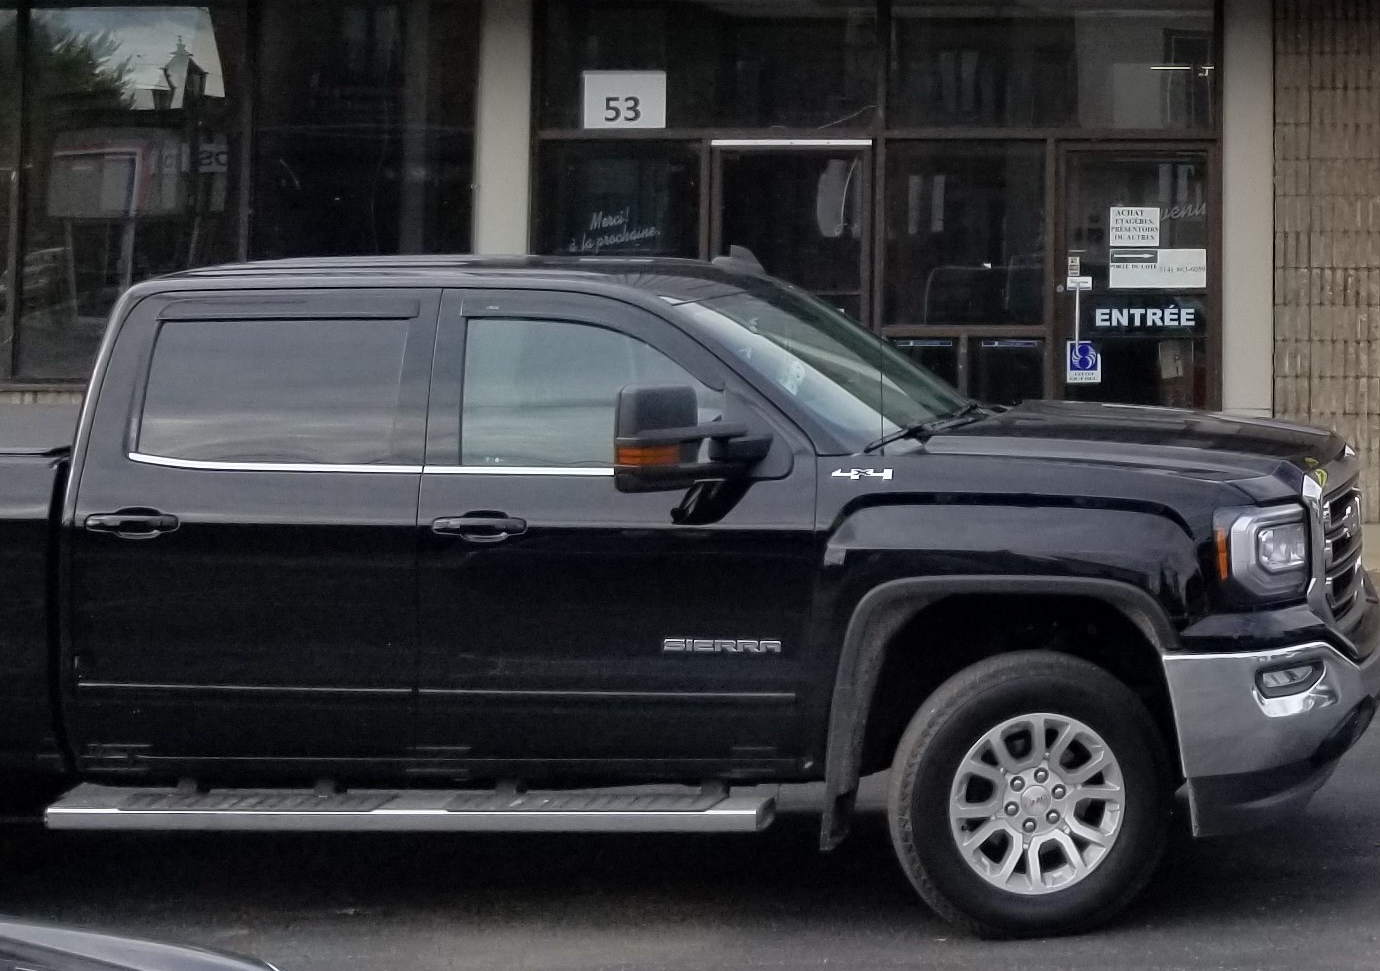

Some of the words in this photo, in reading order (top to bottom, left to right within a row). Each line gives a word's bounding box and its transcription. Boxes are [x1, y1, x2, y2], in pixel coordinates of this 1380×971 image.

[603, 95, 642, 123] 53
[589, 206, 630, 231] Merci!
[582, 232, 595, 251] la
[1095, 304, 1196, 327] ENTRÉE
[663, 638, 782, 653] SIERRA
